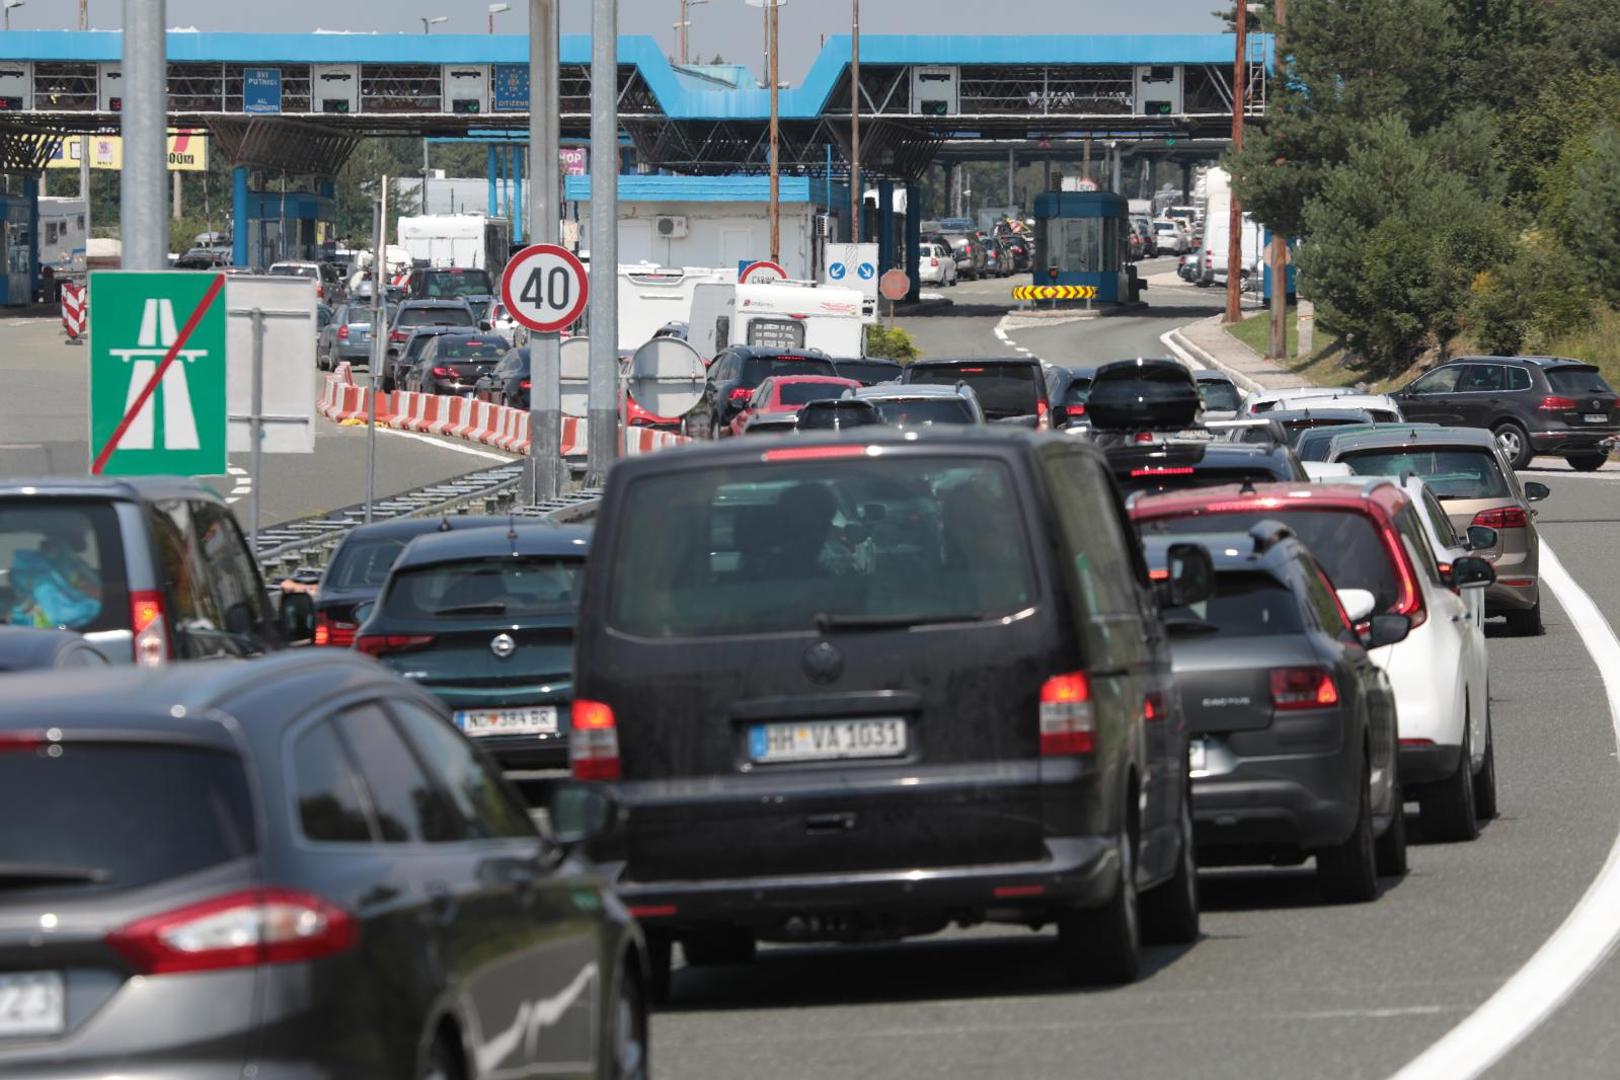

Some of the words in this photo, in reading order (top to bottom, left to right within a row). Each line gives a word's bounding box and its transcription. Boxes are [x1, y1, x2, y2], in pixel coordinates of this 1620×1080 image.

[519, 266, 570, 311] 40
[768, 726, 795, 752] HH
[812, 724, 839, 749] VA
[846, 721, 898, 748] 1031
